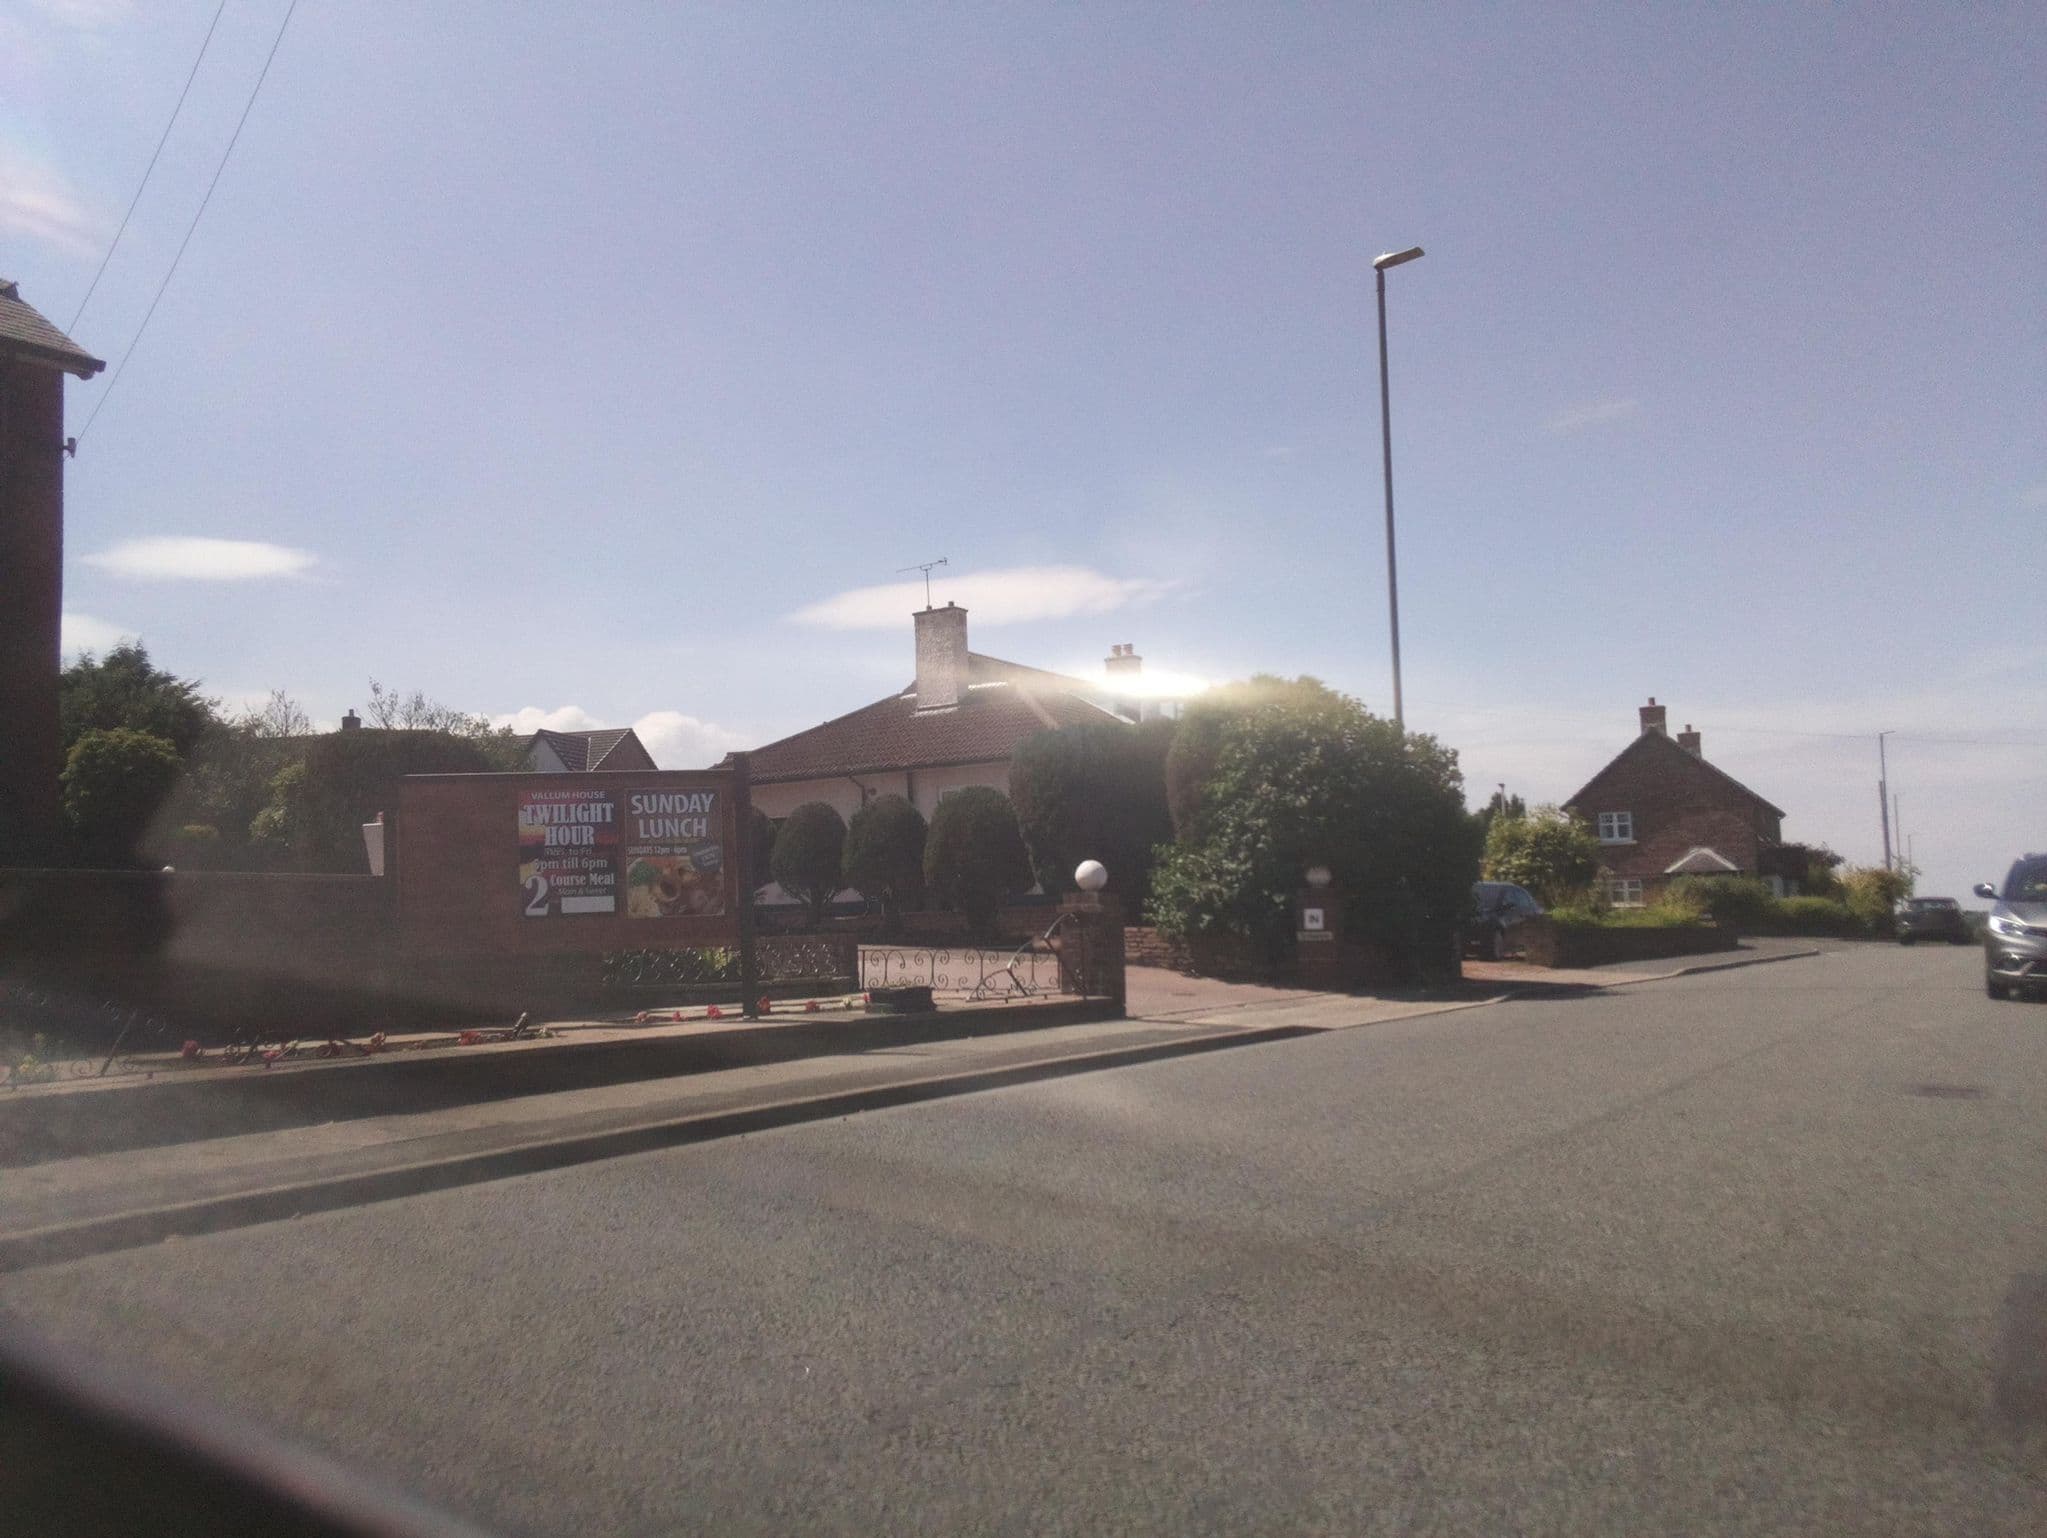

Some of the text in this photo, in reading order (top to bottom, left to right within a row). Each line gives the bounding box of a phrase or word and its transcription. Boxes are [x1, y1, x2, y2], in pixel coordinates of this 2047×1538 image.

[531, 790, 606, 800] VALLUM HOUSE
[631, 793, 715, 815] SUNDAY
[523, 803, 614, 824] TWILIGHT
[544, 825, 595, 846] HOUR
[639, 818, 707, 838] LUNCH
[563, 857, 578, 869] till
[582, 858, 608, 870] 6pm
[550, 872, 615, 886] Course Meal
[525, 875, 549, 916] 2
